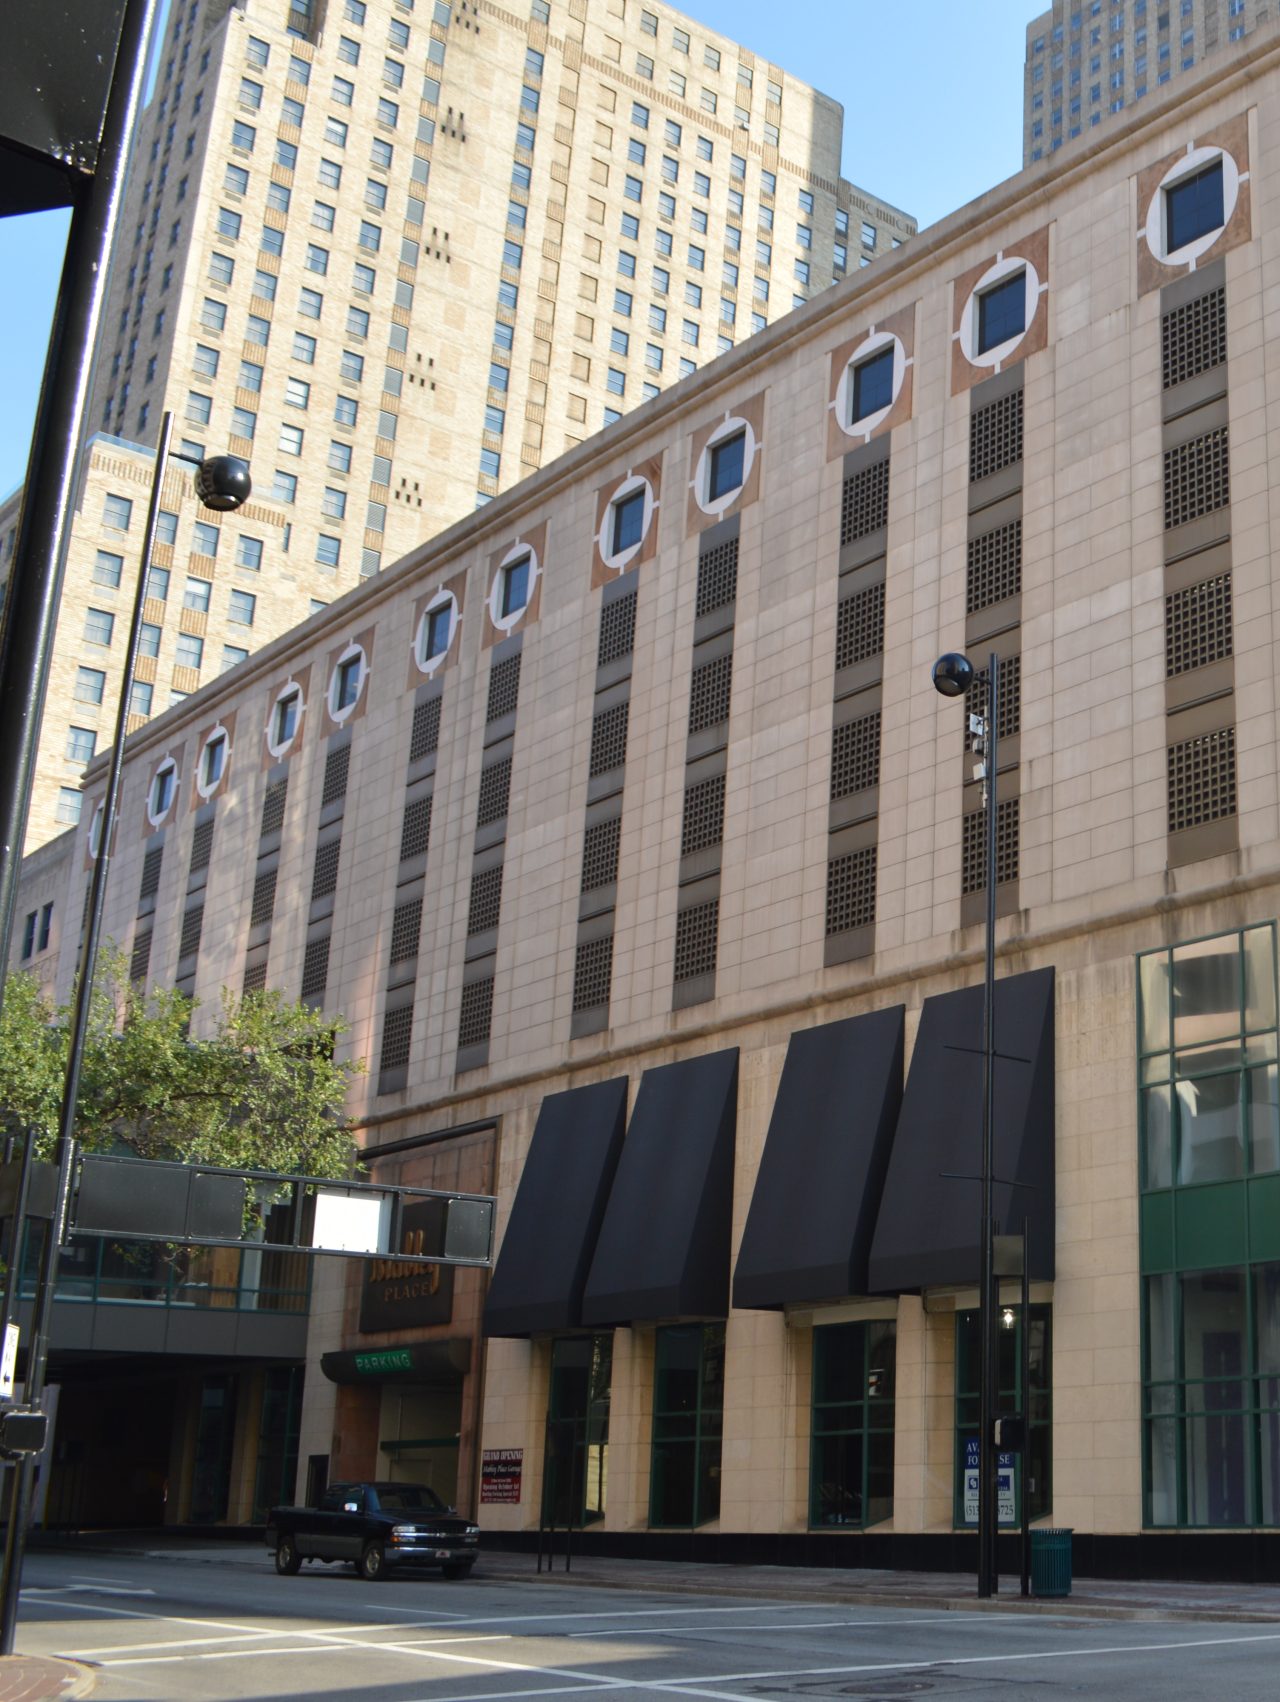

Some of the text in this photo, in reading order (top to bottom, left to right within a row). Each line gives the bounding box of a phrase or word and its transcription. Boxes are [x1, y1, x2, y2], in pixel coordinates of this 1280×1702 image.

[384, 1282, 429, 1302] PLACE
[356, 1353, 411, 1371] PARKING
[967, 1455, 979, 1465] FO
